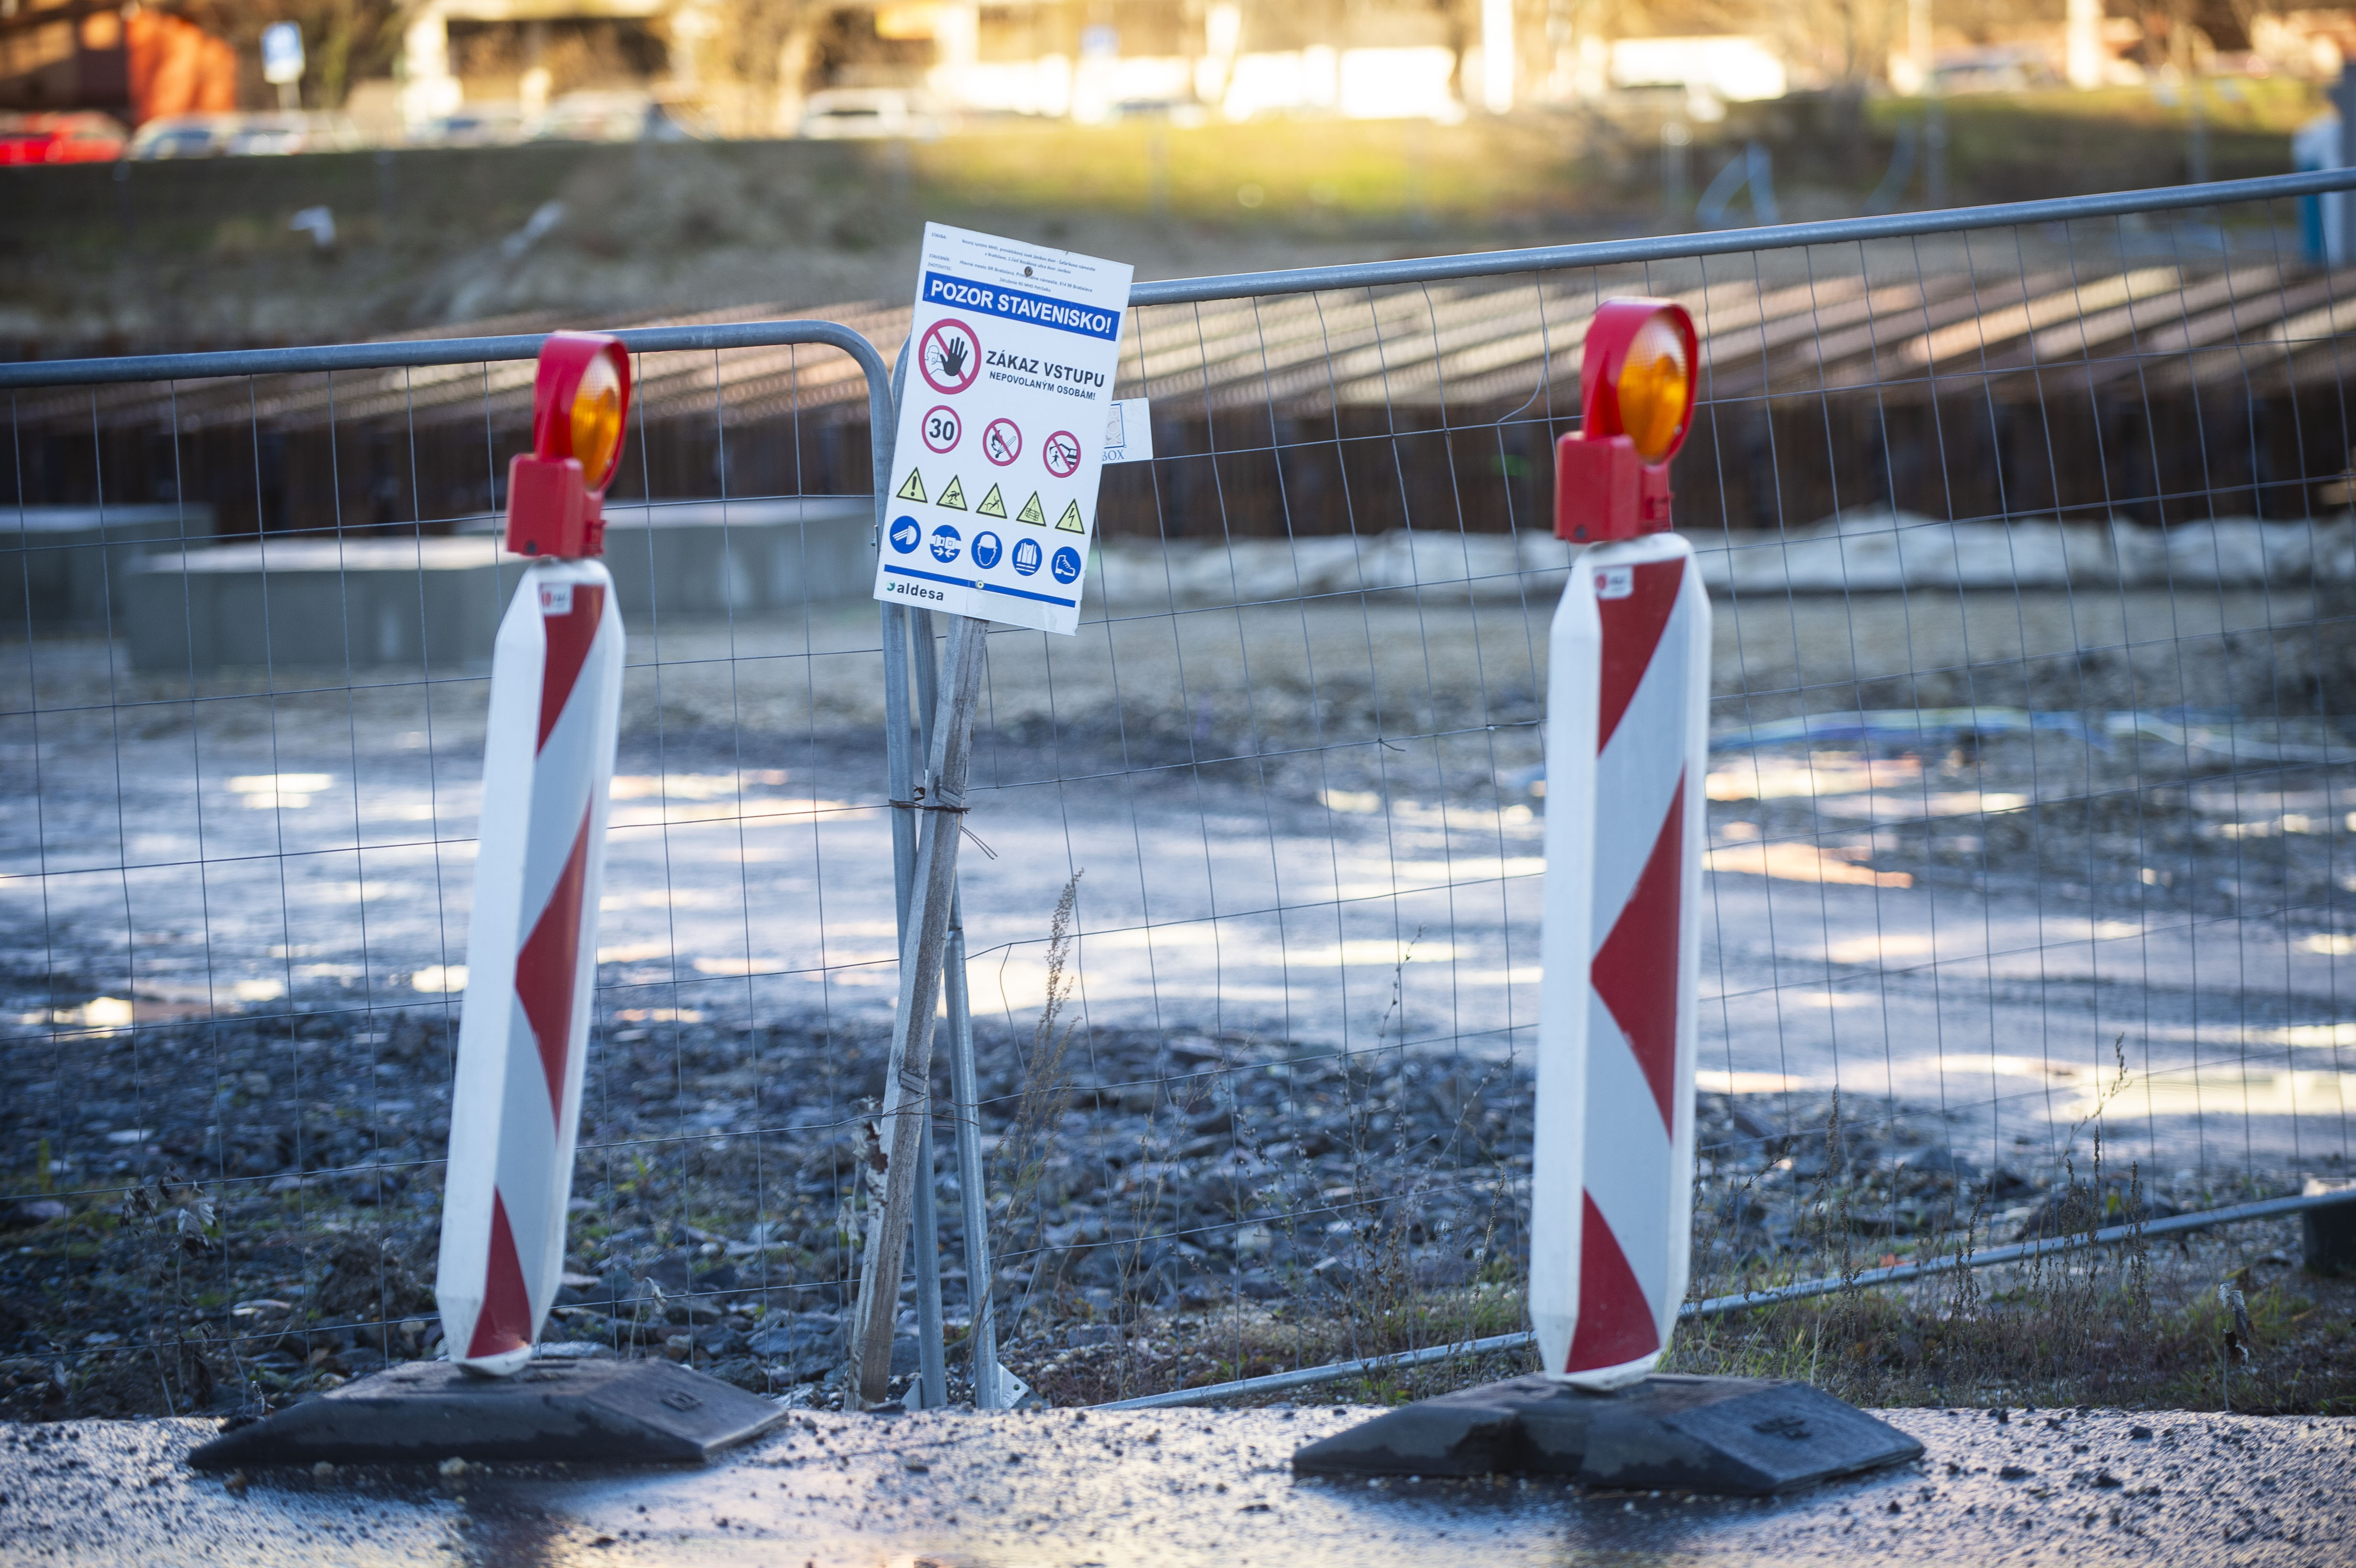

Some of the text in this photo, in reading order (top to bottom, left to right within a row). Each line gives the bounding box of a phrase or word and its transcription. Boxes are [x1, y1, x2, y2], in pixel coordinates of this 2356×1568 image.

[931, 280, 1112, 333] POZOR STAVENISKO!
[986, 349, 1104, 387] ZÁKAZ VSTUPU
[989, 370, 1096, 400] NEPOVOLANÝM OSOBÁM!
[929, 418, 954, 441] 30
[897, 583, 944, 601] aldesa
